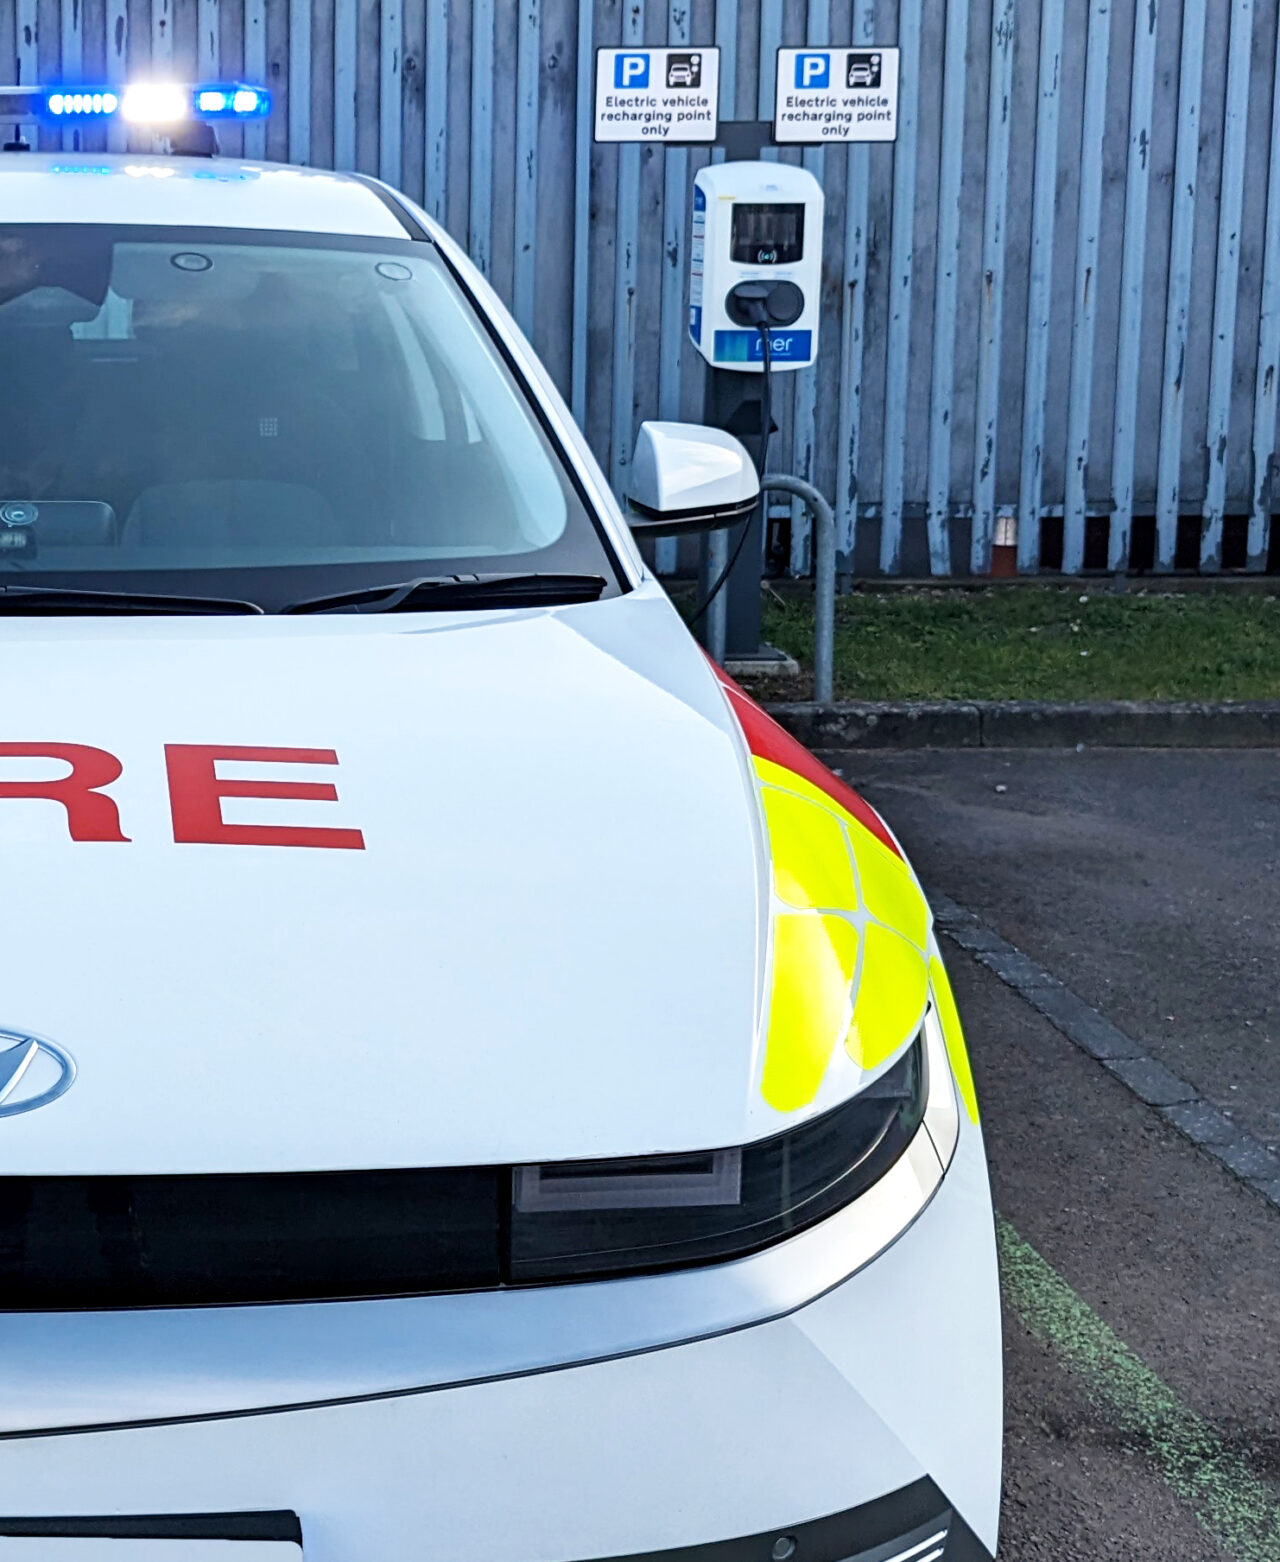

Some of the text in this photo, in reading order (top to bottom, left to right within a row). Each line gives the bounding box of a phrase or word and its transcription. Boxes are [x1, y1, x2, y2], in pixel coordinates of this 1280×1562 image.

[622, 56, 645, 86] P
[803, 56, 825, 86] P
[605, 96, 708, 107] Electric vehicle
[786, 96, 888, 107] Electric vehicle
[601, 110, 711, 122] recharging point
[781, 110, 891, 122] recharging point
[641, 124, 670, 137] only
[822, 124, 850, 137] only
